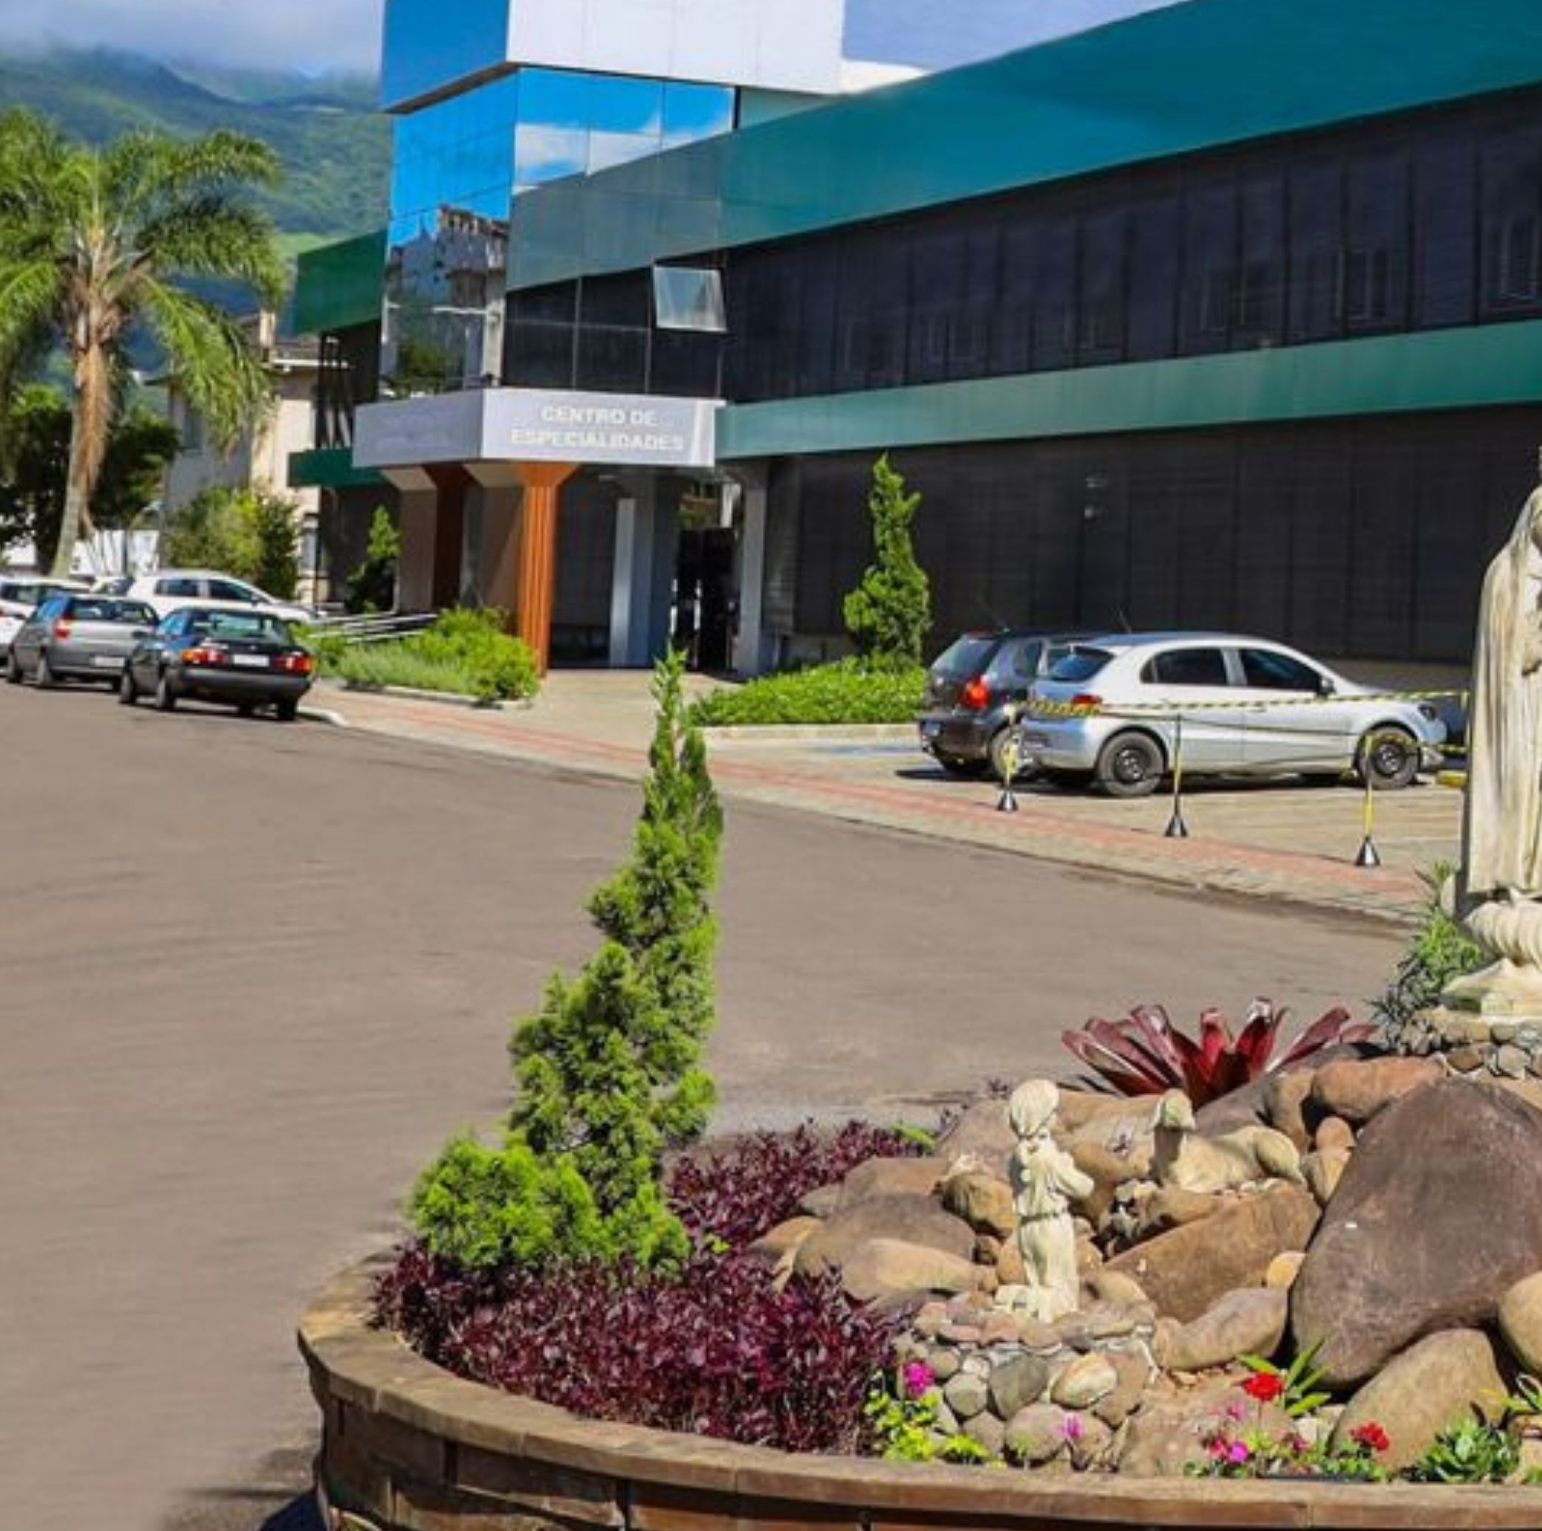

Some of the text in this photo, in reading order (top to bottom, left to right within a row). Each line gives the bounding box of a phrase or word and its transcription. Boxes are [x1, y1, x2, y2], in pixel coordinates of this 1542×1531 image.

[540, 405, 659, 427] CENTRO DE
[509, 428, 685, 451] ESPECIALIDADES
